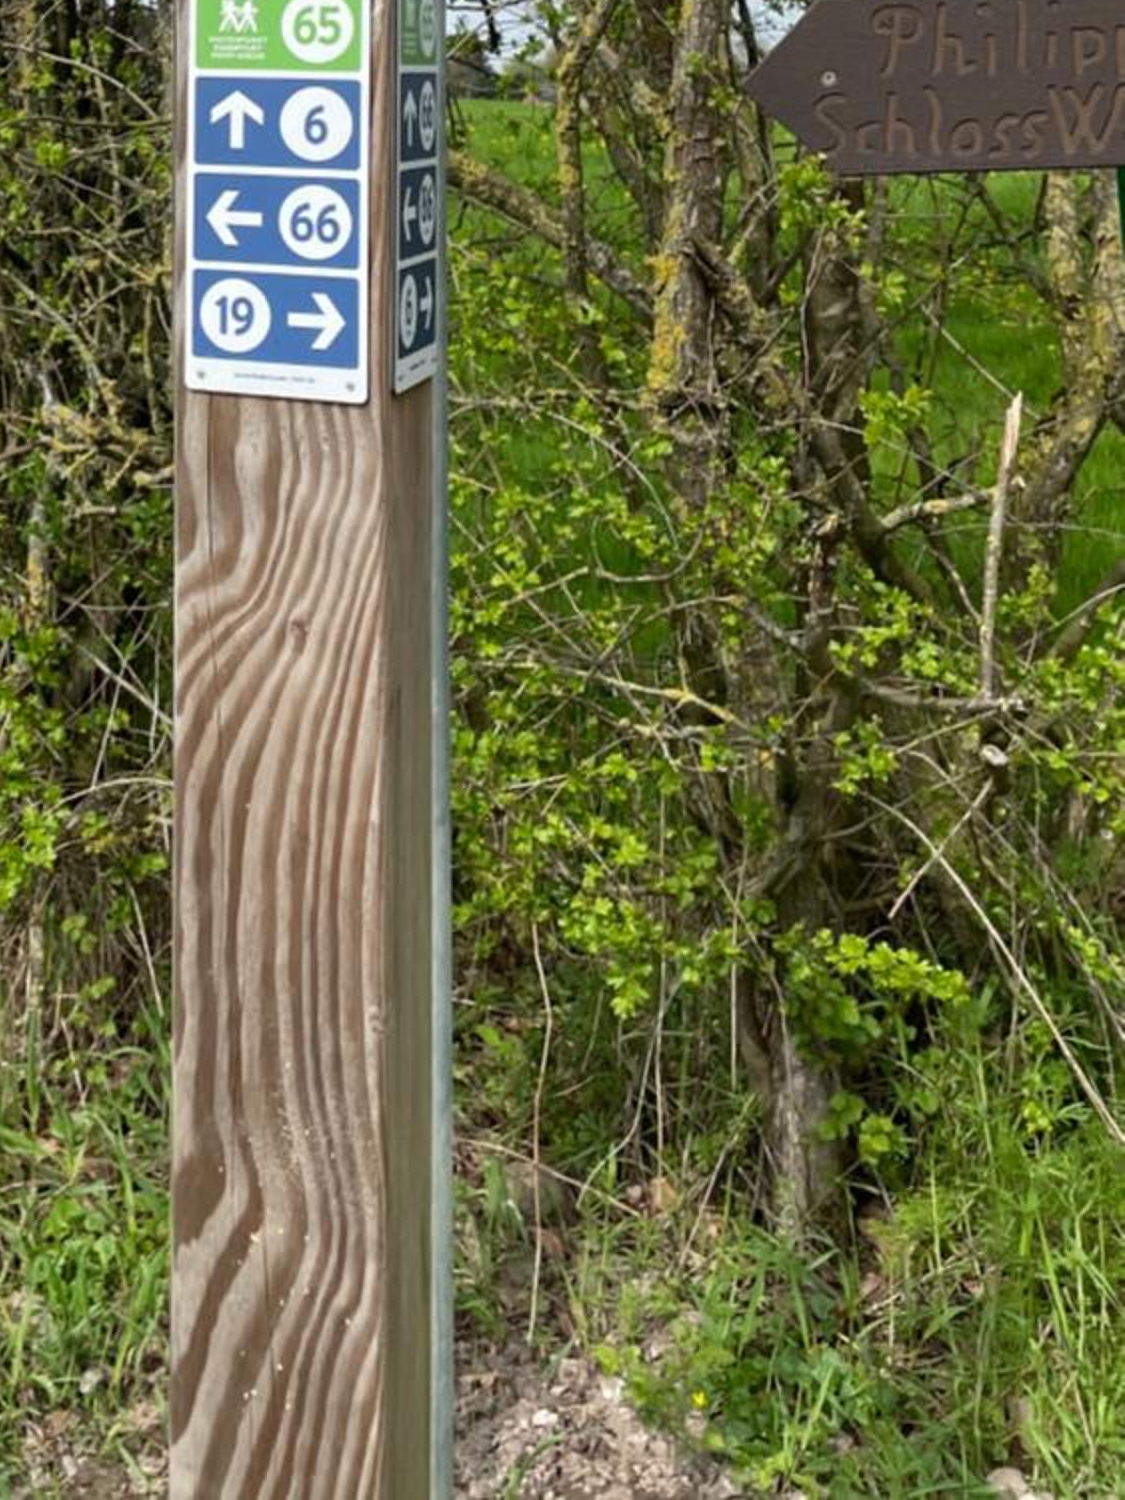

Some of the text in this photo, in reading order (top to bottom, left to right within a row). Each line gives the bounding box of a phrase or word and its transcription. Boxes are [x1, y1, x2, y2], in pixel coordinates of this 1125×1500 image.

[293, 5, 342, 46] 65
[304, 104, 329, 145] 6
[290, 203, 341, 244] 66
[214, 296, 255, 336] 19
